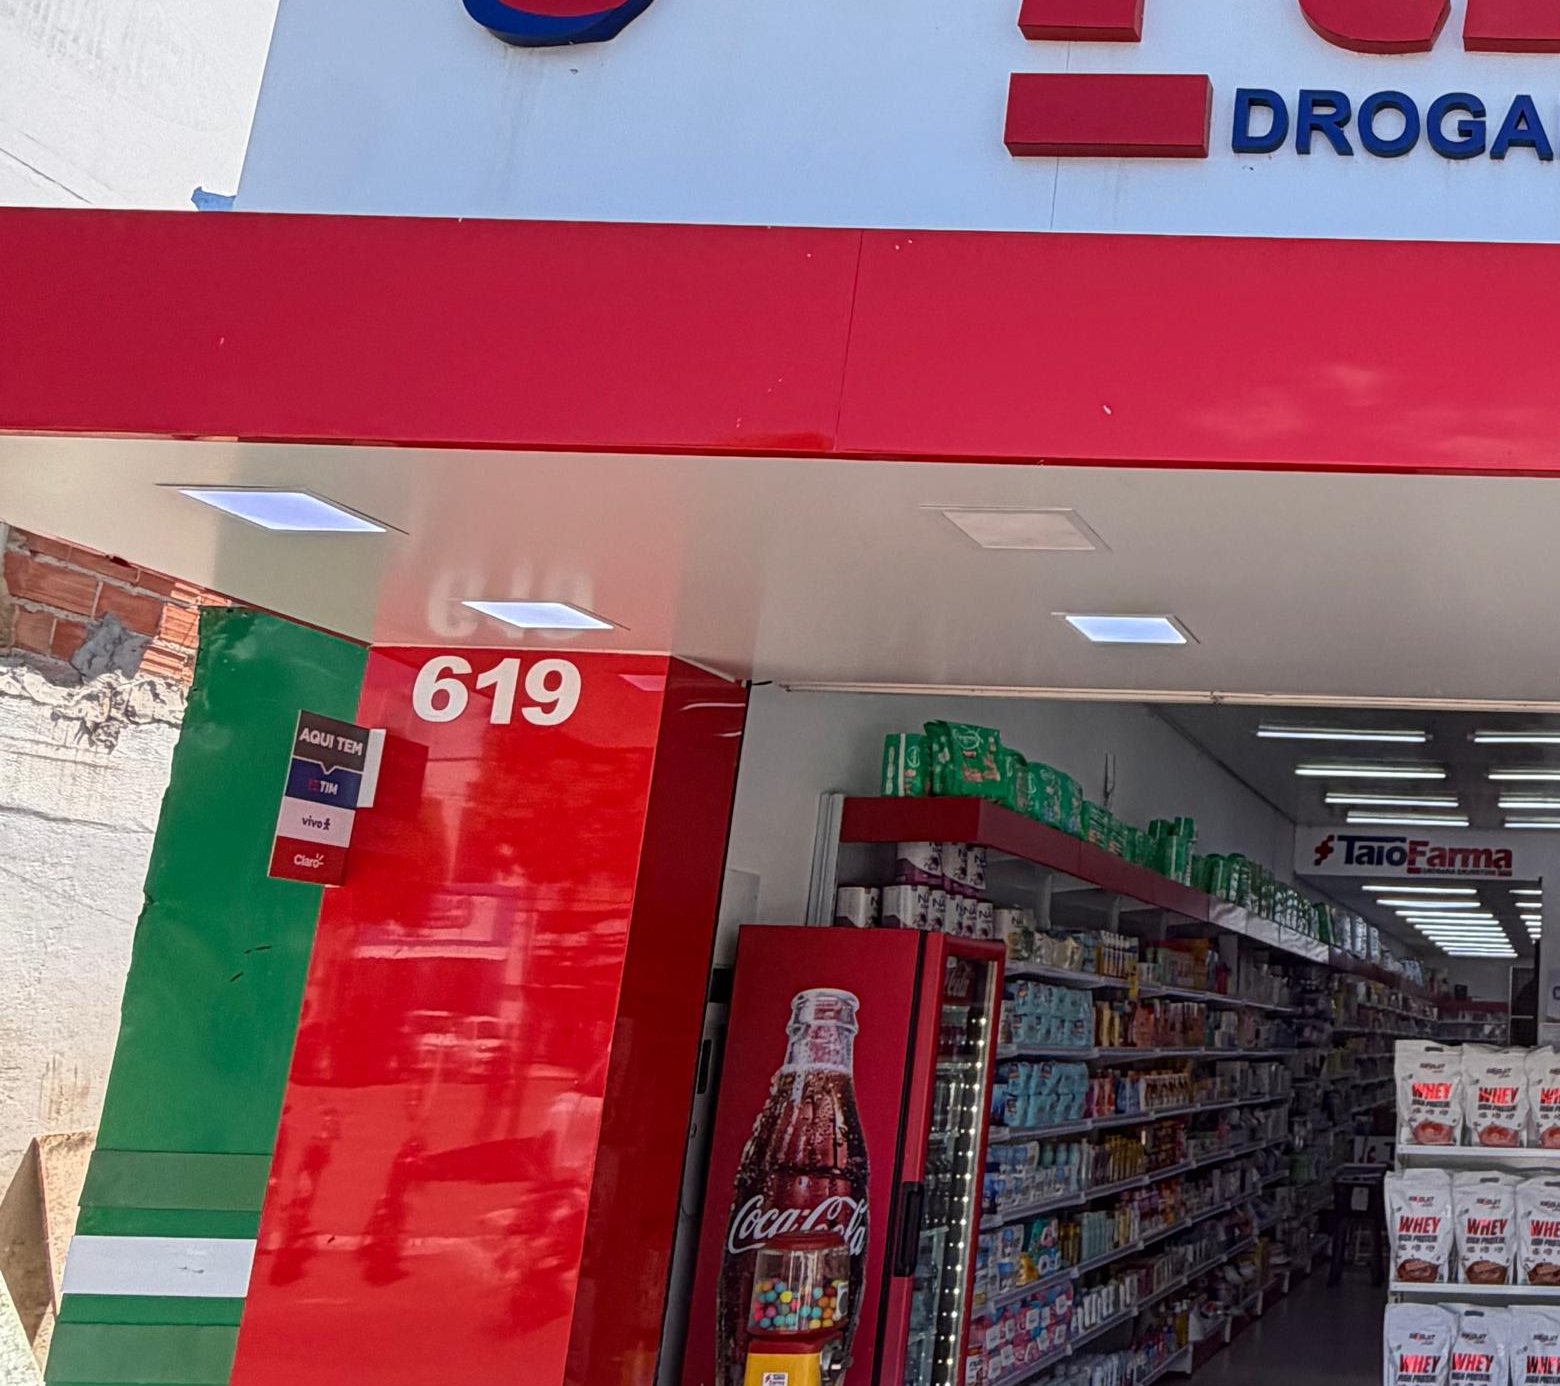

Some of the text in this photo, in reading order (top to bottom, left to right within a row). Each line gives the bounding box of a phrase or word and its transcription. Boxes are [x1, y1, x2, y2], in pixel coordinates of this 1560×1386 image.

[412, 655, 582, 727] 619
[299, 727, 363, 756] AQUI TEM
[320, 780, 338, 796] TIM
[302, 815, 323, 830] vivo
[294, 854, 320, 869] Claro
[1412, 1083, 1452, 1100] WHEY
[1478, 1087, 1519, 1104] WHEY
[1398, 1215, 1441, 1234] WHEY
[1467, 1217, 1508, 1236] WHEY
[1399, 1354, 1442, 1373] WHEY
[1451, 1353, 1494, 1372] WHEY
